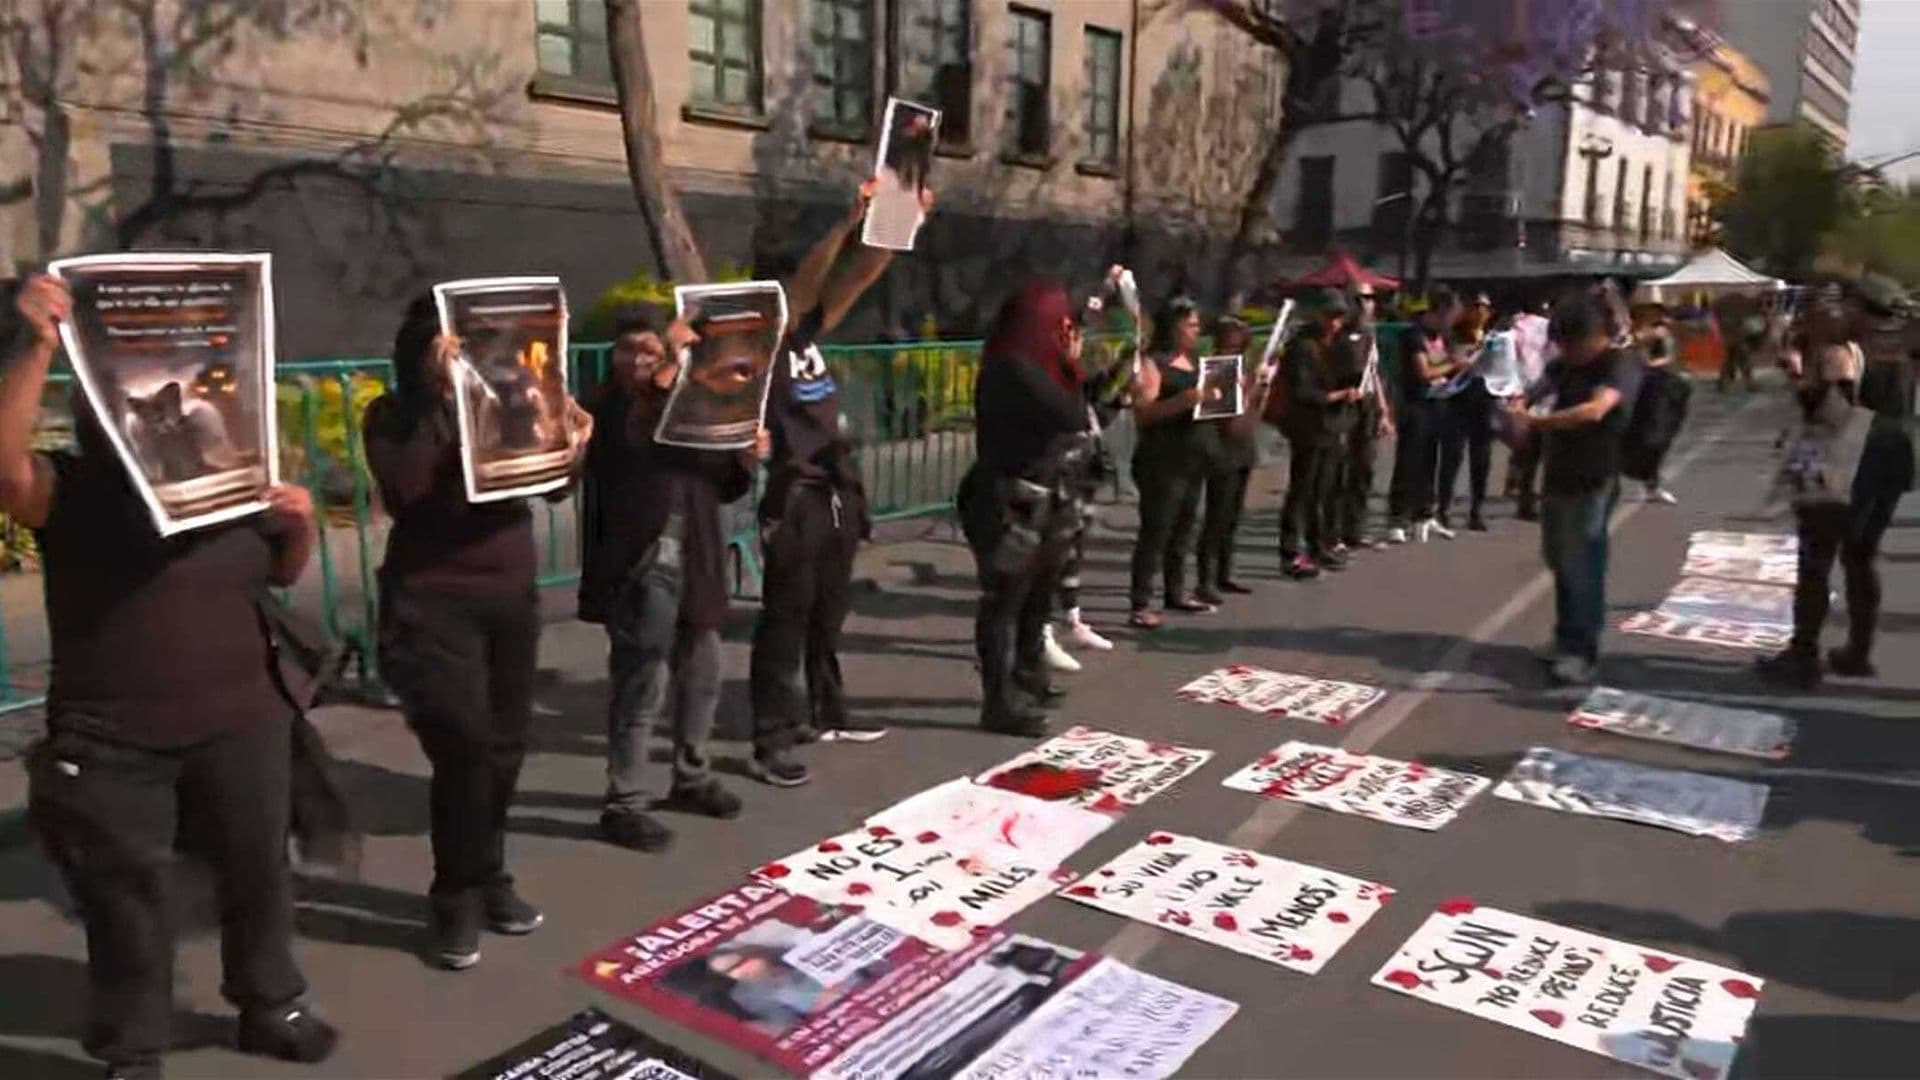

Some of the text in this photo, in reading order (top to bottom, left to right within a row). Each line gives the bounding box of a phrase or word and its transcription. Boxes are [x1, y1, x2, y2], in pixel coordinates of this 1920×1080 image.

[804, 837, 904, 881] NO ES
[872, 862, 922, 882] 1
[1102, 851, 1190, 898] SU VIDA
[959, 864, 1037, 910] MILES
[1205, 875, 1263, 908] VALE
[624, 872, 777, 960] ¡ALERTA!
[1417, 921, 1518, 984] SCJN
[1475, 936, 1560, 1009] NO REDUCE
[1577, 963, 1640, 1029] REDUCE
